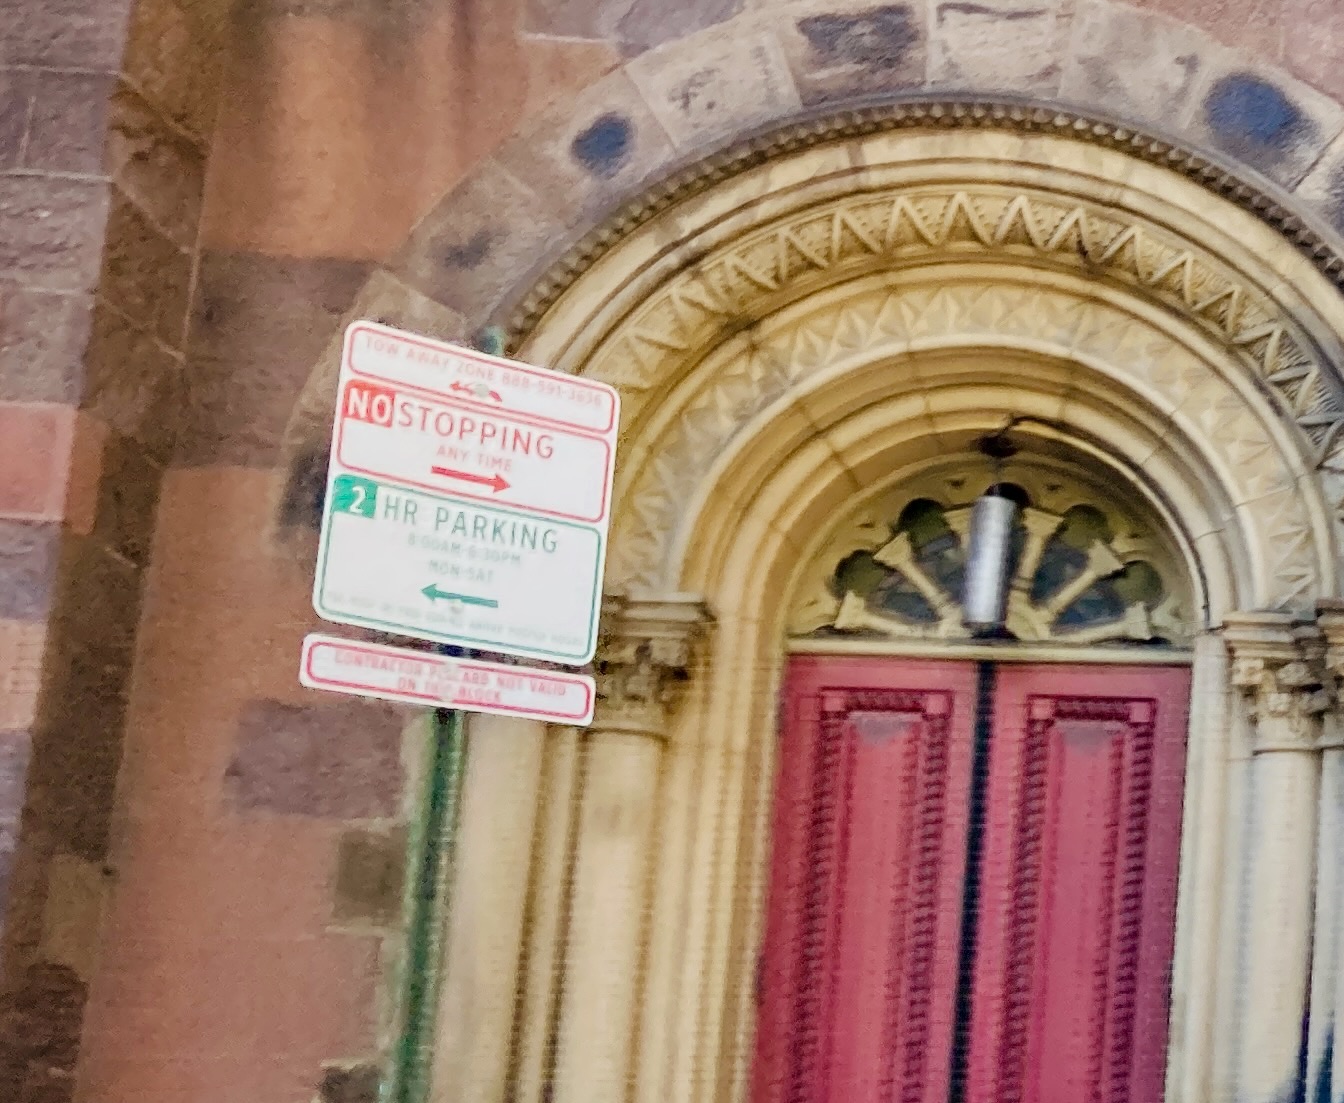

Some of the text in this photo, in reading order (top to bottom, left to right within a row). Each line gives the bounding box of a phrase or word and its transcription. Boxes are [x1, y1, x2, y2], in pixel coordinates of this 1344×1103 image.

[365, 337, 398, 356] TOW
[405, 347, 449, 369] AWAY
[455, 360, 496, 382] ZONE
[349, 387, 555, 459] NO STOPPING
[436, 444, 514, 473] ANY TIME
[348, 485, 560, 555] 2 HR PARKING
